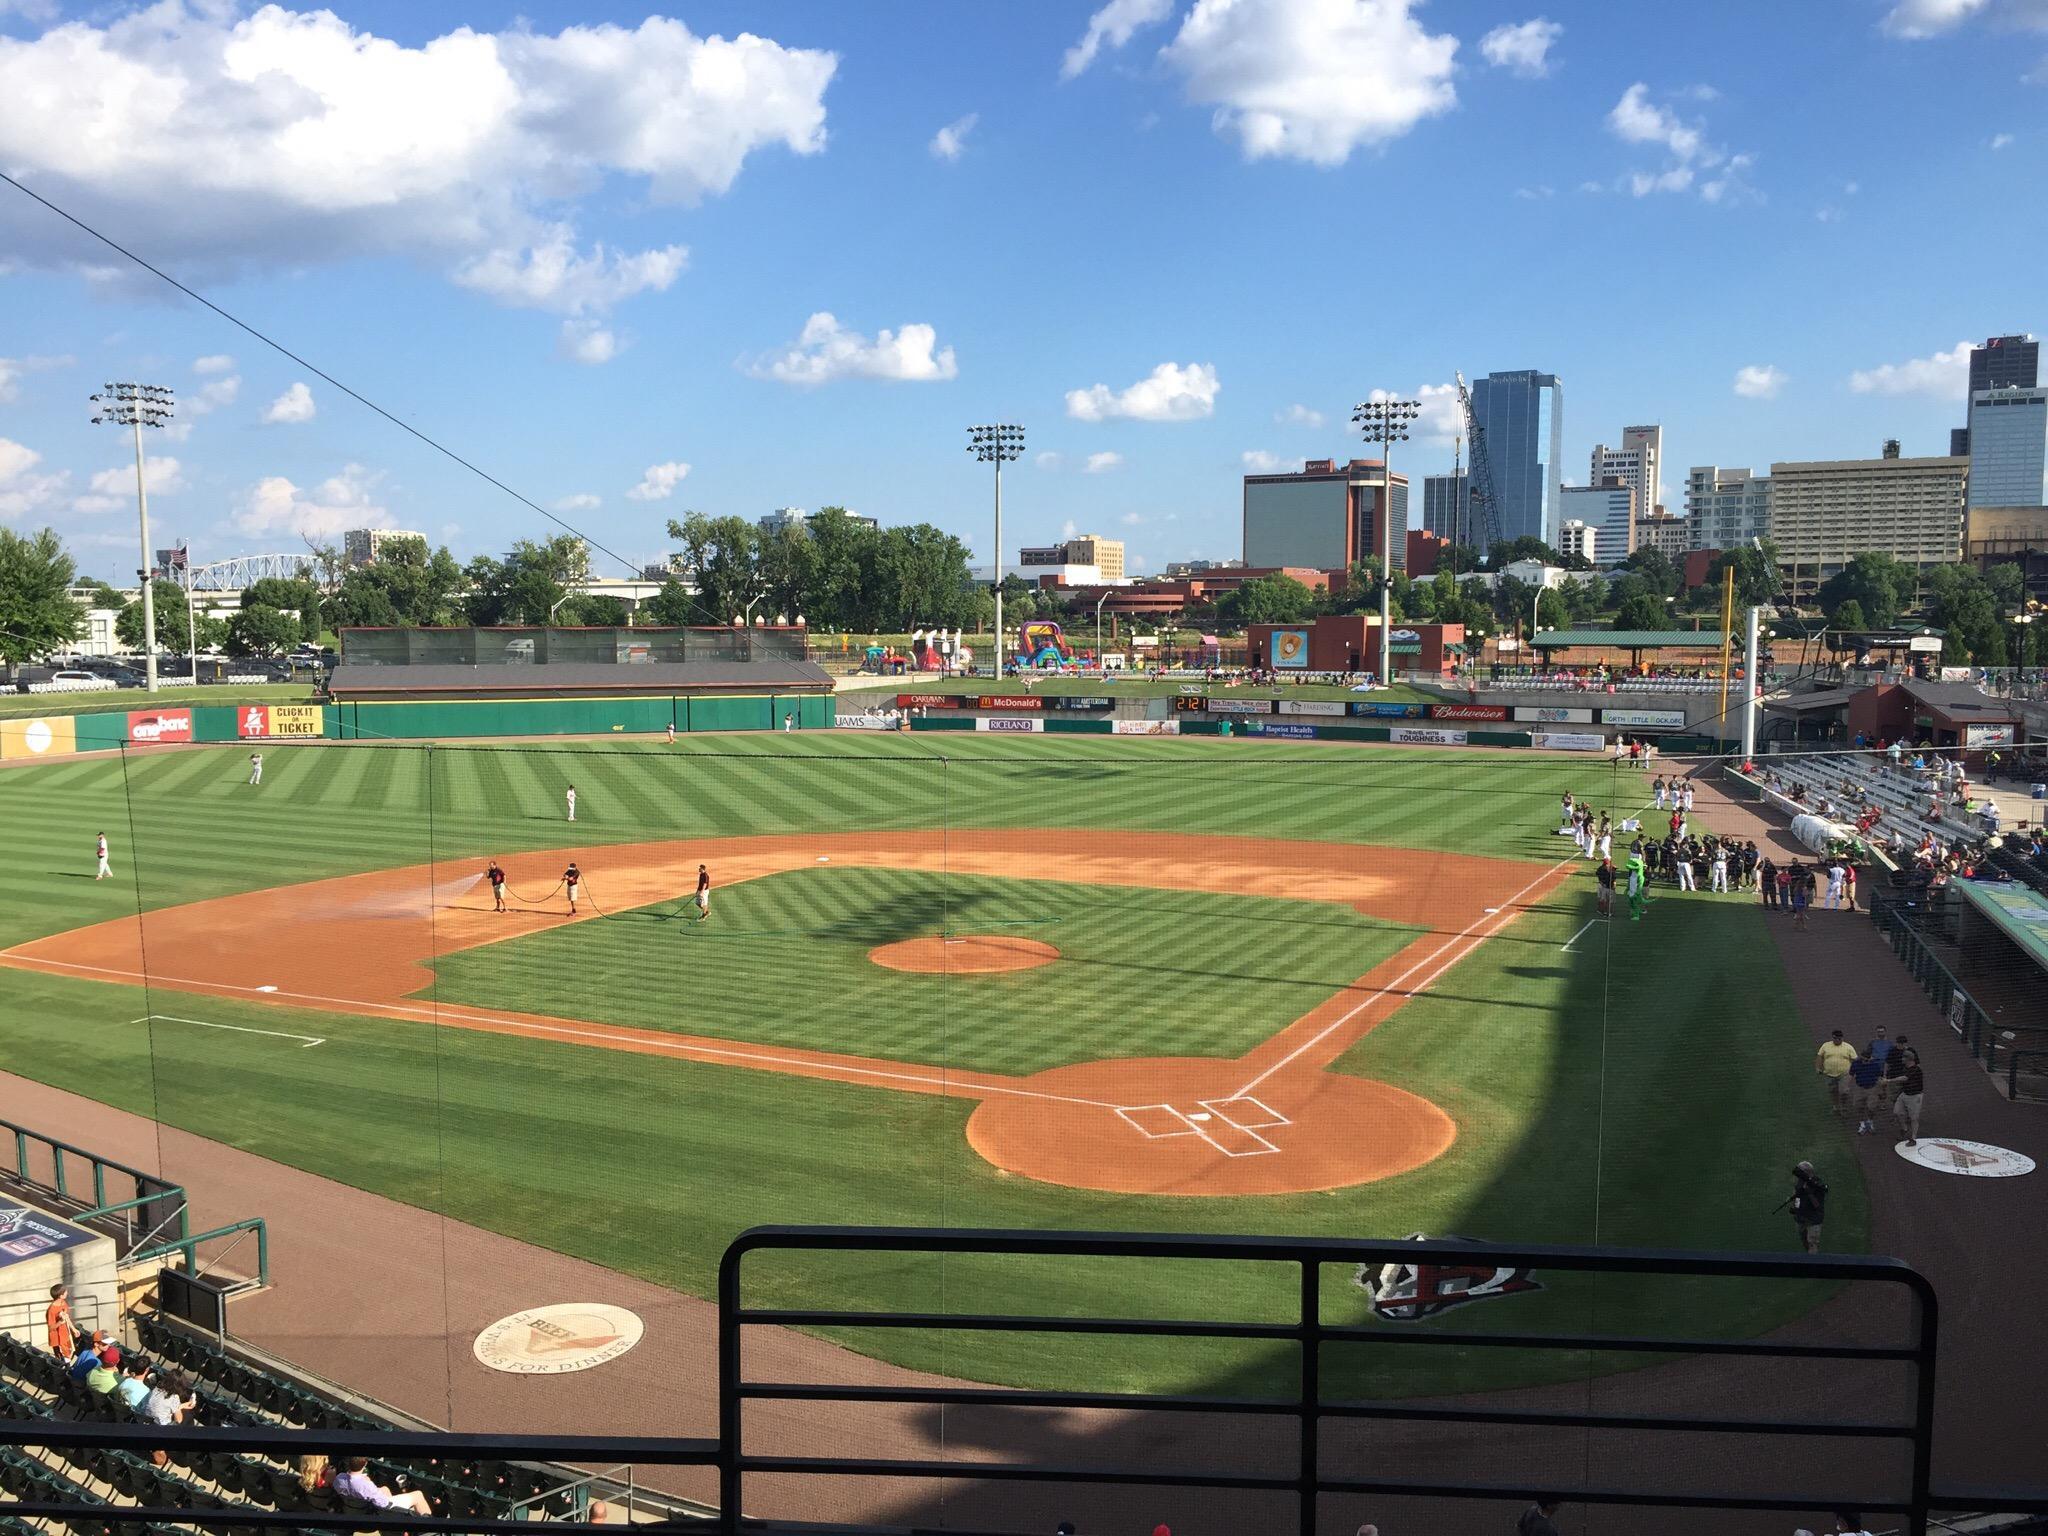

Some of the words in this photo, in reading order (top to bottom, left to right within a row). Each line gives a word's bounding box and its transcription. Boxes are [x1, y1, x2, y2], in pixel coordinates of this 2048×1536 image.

[994, 698, 1042, 707] McDonald's
[1081, 697, 1109, 705] AMSTERDAM
[277, 707, 304, 718] CLICK
[305, 707, 313, 718] IT
[1303, 703, 1333, 711] HARDING
[1433, 705, 1504, 719] Budweiser
[835, 717, 864, 727] UAMS
[990, 719, 1031, 730] RICELAND
[278, 722, 315, 734] TICKET
[1266, 725, 1288, 734] Baptist
[1290, 726, 1312, 734] Health
[1399, 735, 1446, 743] TOUGHNESS
[22, 1220, 60, 1237] PRESENTED
[527, 1318, 577, 1338] BEEF
[507, 1362, 551, 1373] FOR
[558, 1340, 633, 1372] DINNER
